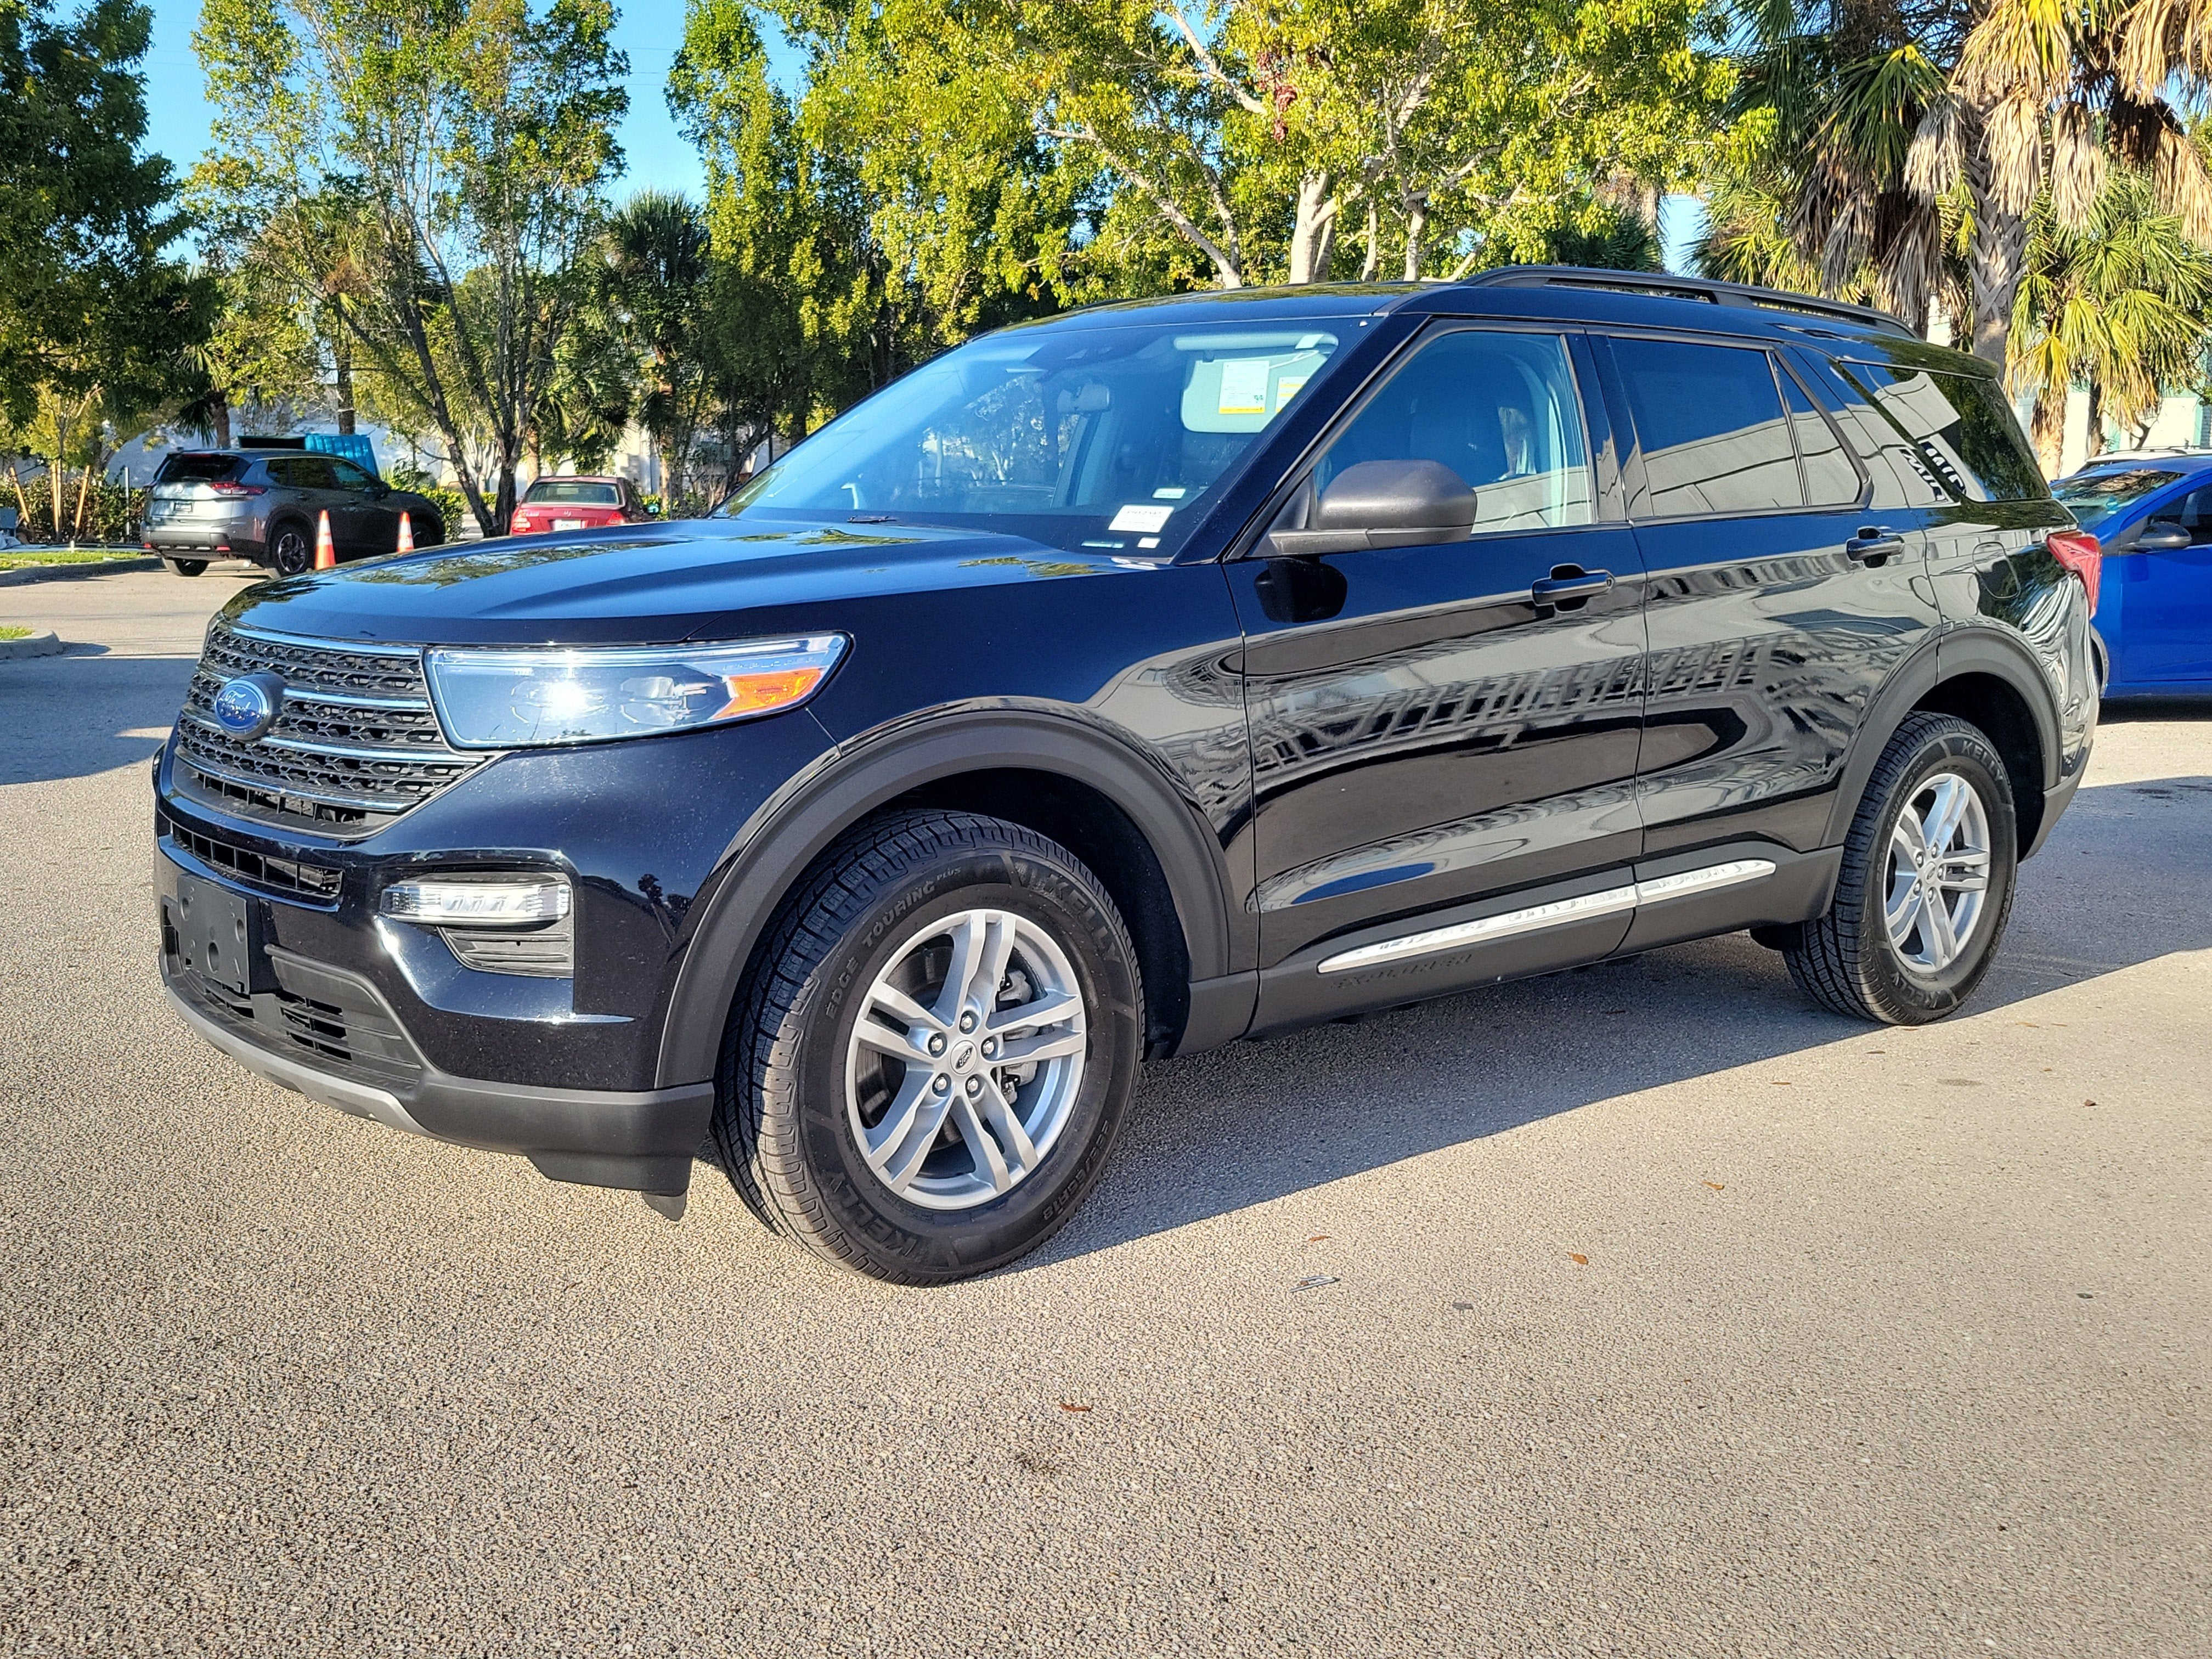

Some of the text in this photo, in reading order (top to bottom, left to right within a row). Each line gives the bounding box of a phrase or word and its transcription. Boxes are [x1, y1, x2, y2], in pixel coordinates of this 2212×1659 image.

[826, 866, 961, 1019] EDGE TOURING PLUS
[1043, 873, 1121, 963] KELLY
